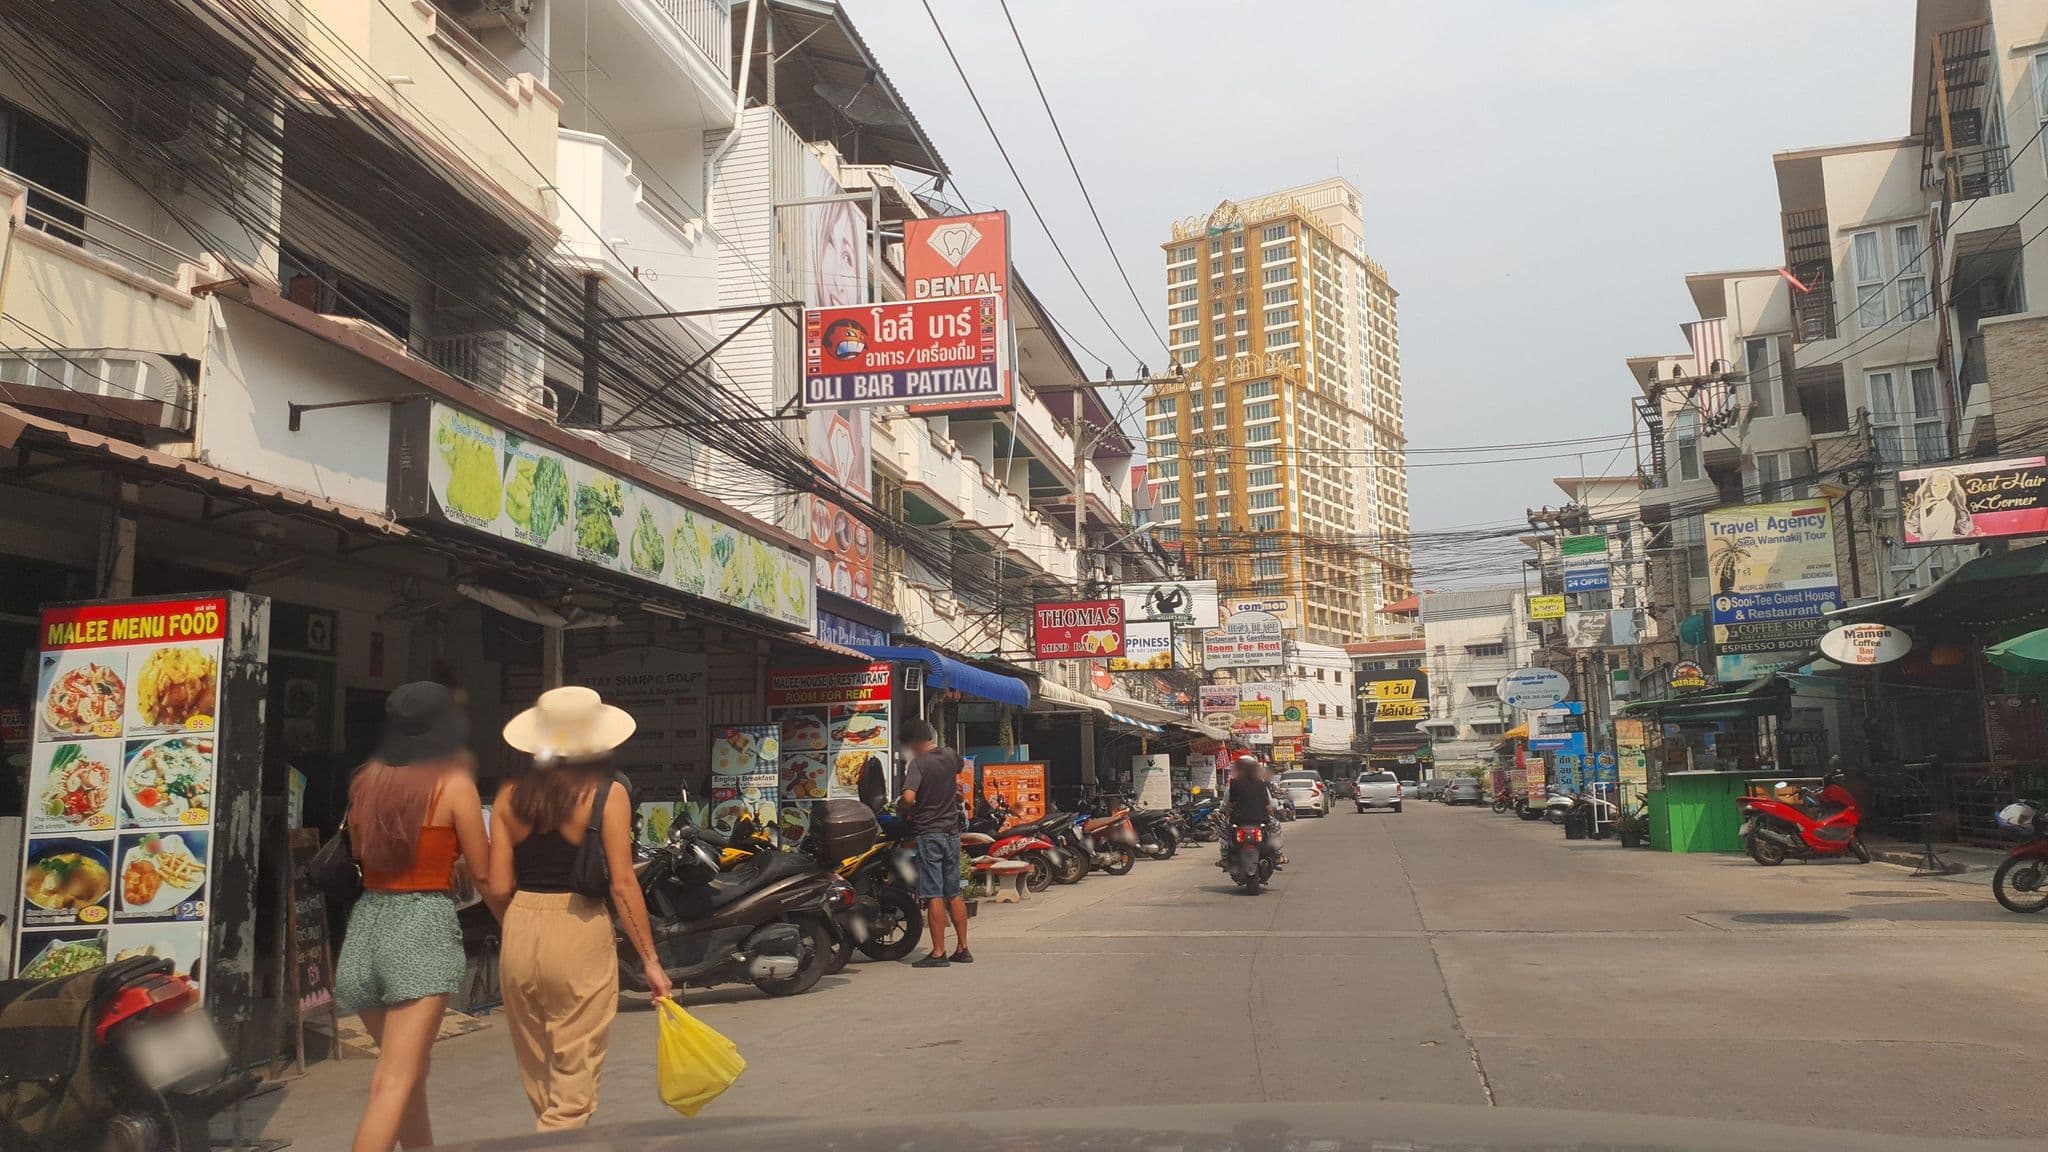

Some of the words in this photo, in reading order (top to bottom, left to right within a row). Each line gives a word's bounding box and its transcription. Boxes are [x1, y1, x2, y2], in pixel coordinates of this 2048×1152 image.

[915, 273, 1002, 298] DENTAL
[870, 306, 914, 342] โอลี่
[928, 306, 972, 339] บาร์
[810, 377, 842, 401] OLI
[854, 373, 895, 398] BAR
[906, 366, 993, 396] PATTAYA
[1966, 475, 2000, 495] Best
[2001, 472, 2046, 489] Hair
[1987, 494, 2037, 510] Corner
[1710, 518, 1759, 536] Travel
[1767, 514, 1826, 533] Agency
[514, 527, 528, 541] Beef
[1737, 537, 1756, 547] Sea
[1805, 531, 1827, 541] Tour
[1567, 579, 1579, 588] 24
[1580, 577, 1608, 586] OPEN
[1802, 571, 1834, 580] BOOKING
[1739, 583, 1764, 592] WORLD
[1774, 592, 1803, 605] Guest
[1804, 590, 1836, 601] House
[1039, 607, 1120, 629] THOMAS
[1735, 610, 1746, 621] &
[1748, 604, 1819, 620] Restaurant
[48, 620, 108, 646] MALEE
[111, 615, 165, 640] MENU
[169, 611, 219, 637] FOOD
[819, 619, 837, 643] Bar
[1738, 622, 1782, 635] COFFEE
[1786, 619, 1818, 631] SHOP
[1073, 642, 1095, 652] BAR
[1126, 637, 1170, 648] PPINESS
[1206, 644, 1234, 653] Room
[1237, 643, 1253, 651] For
[1257, 642, 1280, 651] Rent
[1721, 642, 1776, 653] ESPRESSO
[1853, 639, 1881, 647] Coffee
[1857, 655, 1877, 663] Beer
[836, 670, 890, 686] RESTAURANT
[1671, 680, 1706, 689] BURGER
[786, 690, 817, 702] ROOM
[820, 689, 842, 700] FOR
[846, 688, 873, 700] RENT
[1244, 683, 1281, 693] COCORICO
[1383, 685, 1389, 695] 1
[1393, 683, 1410, 695] วัน
[1381, 703, 1414, 716] ได้เงิน
[714, 775, 741, 784] English
[741, 774, 776, 783] Breakfast
